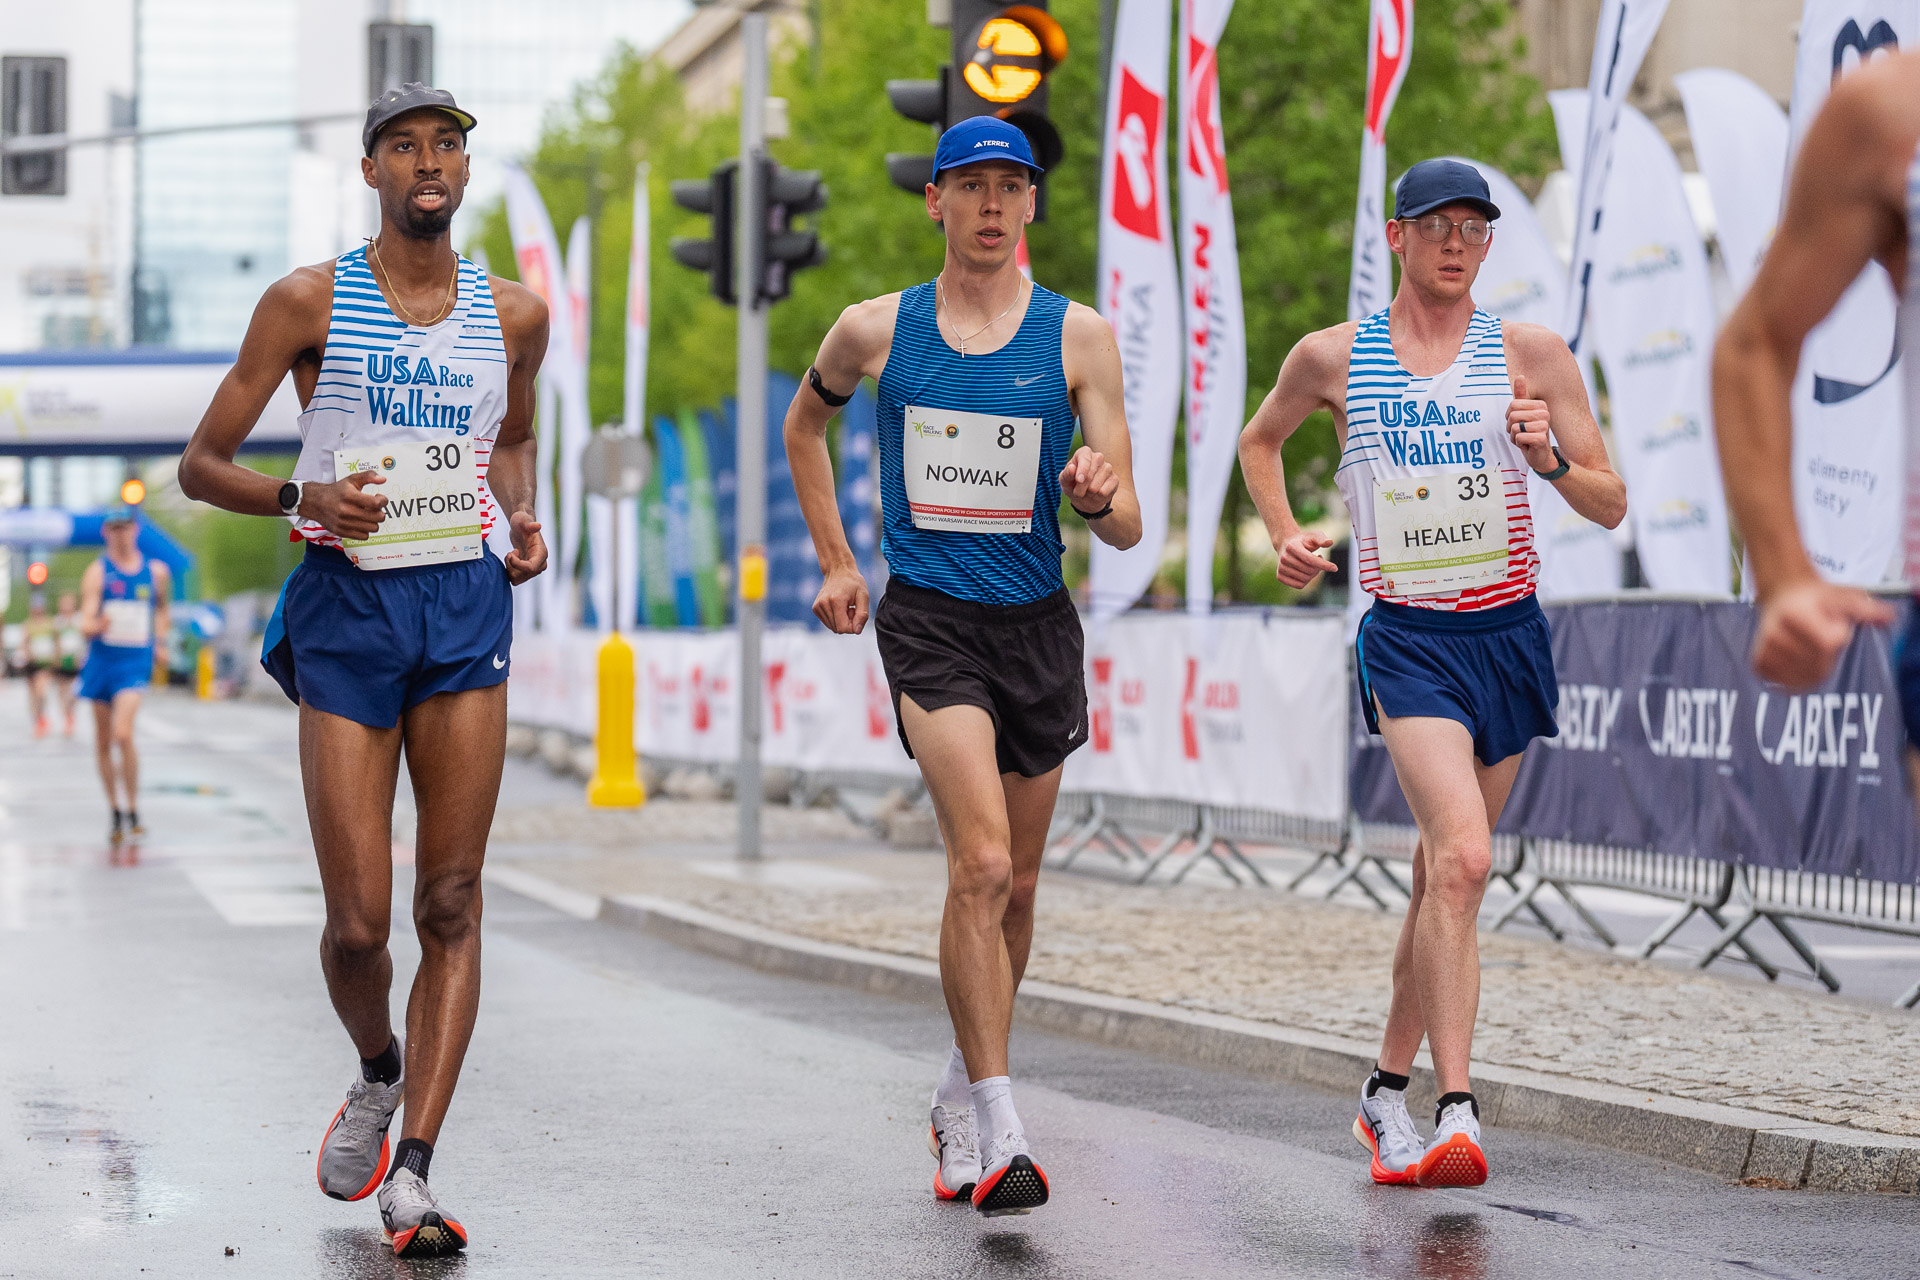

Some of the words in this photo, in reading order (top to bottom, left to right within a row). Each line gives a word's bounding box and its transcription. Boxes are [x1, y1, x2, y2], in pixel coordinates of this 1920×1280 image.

[982, 140, 1010, 148] TERREX
[367, 354, 438, 386] USA
[439, 366, 474, 388] Race
[366, 386, 473, 436] Walking
[1379, 400, 1446, 428] USA
[1446, 406, 1481, 426] Race
[997, 424, 1015, 449] 8
[425, 444, 460, 471] 30
[1381, 430, 1486, 470] Walking
[926, 464, 1008, 487] NOWAK
[1458, 474, 1490, 500] 33
[383, 493, 476, 519] AWFORD
[938, 516, 962, 524] WARSAW
[431, 530, 455, 538] WALKING
[1404, 522, 1486, 548] HEALEY
[1424, 560, 1448, 568] WARSAW
